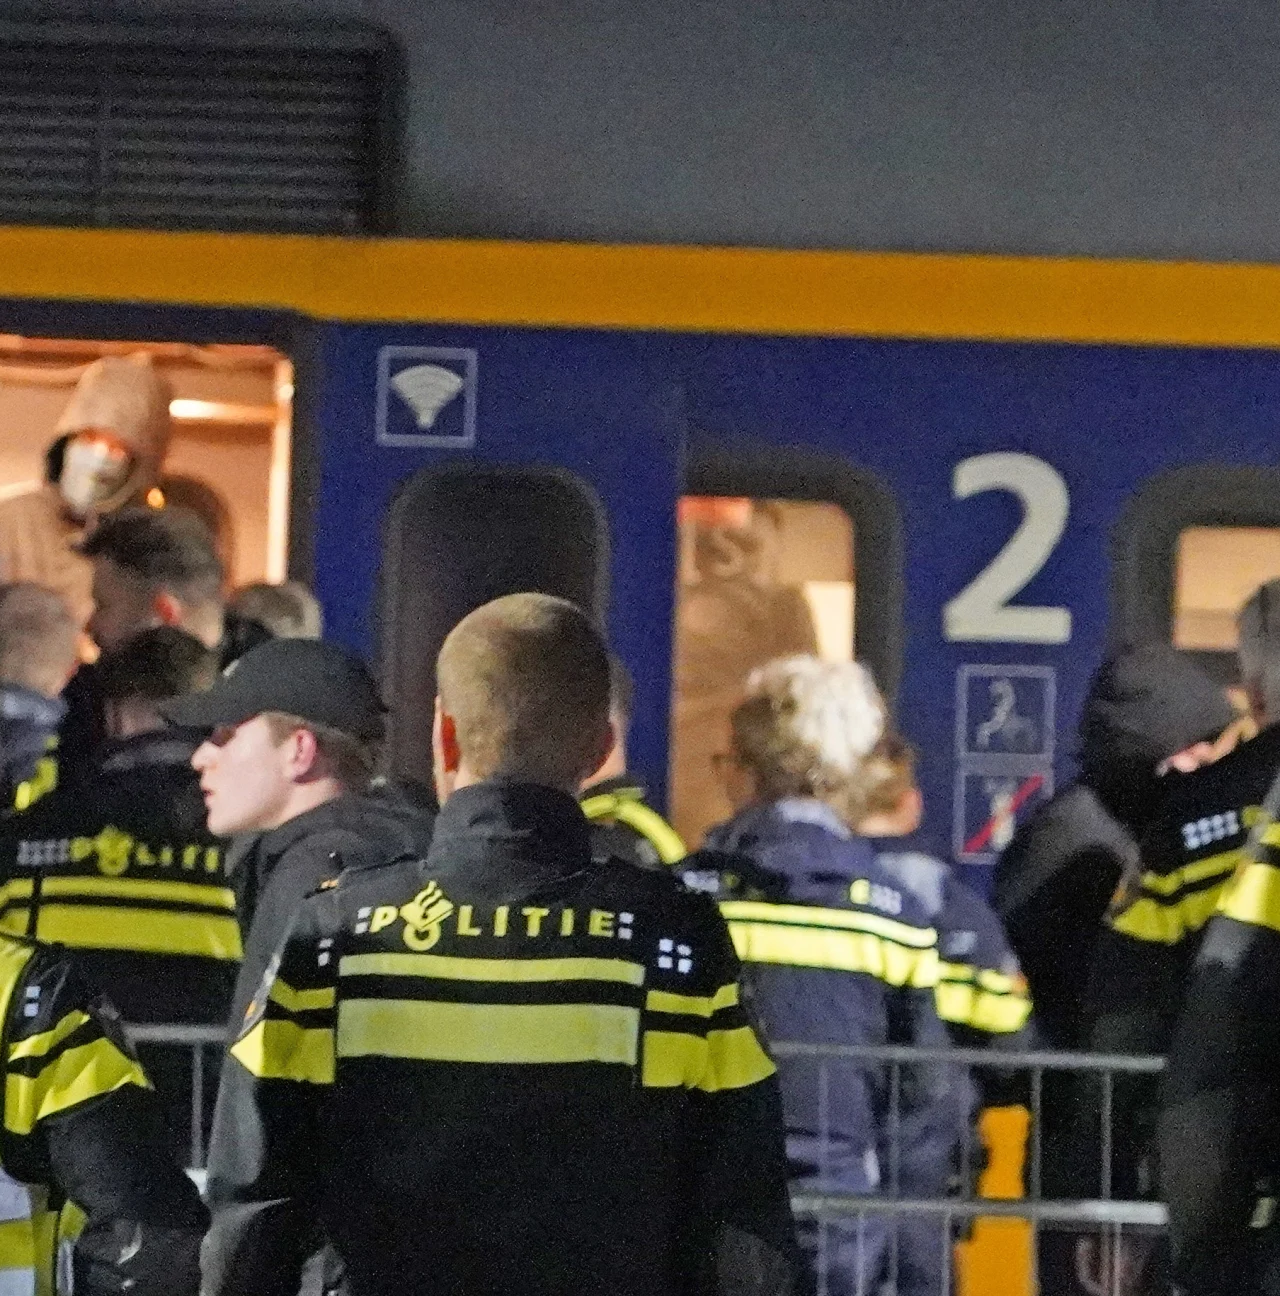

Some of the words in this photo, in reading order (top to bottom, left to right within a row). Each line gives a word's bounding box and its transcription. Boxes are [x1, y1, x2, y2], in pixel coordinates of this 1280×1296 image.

[943, 451, 1072, 645] 2
[70, 824, 220, 876] POLITI
[370, 880, 616, 951] POLITIE
